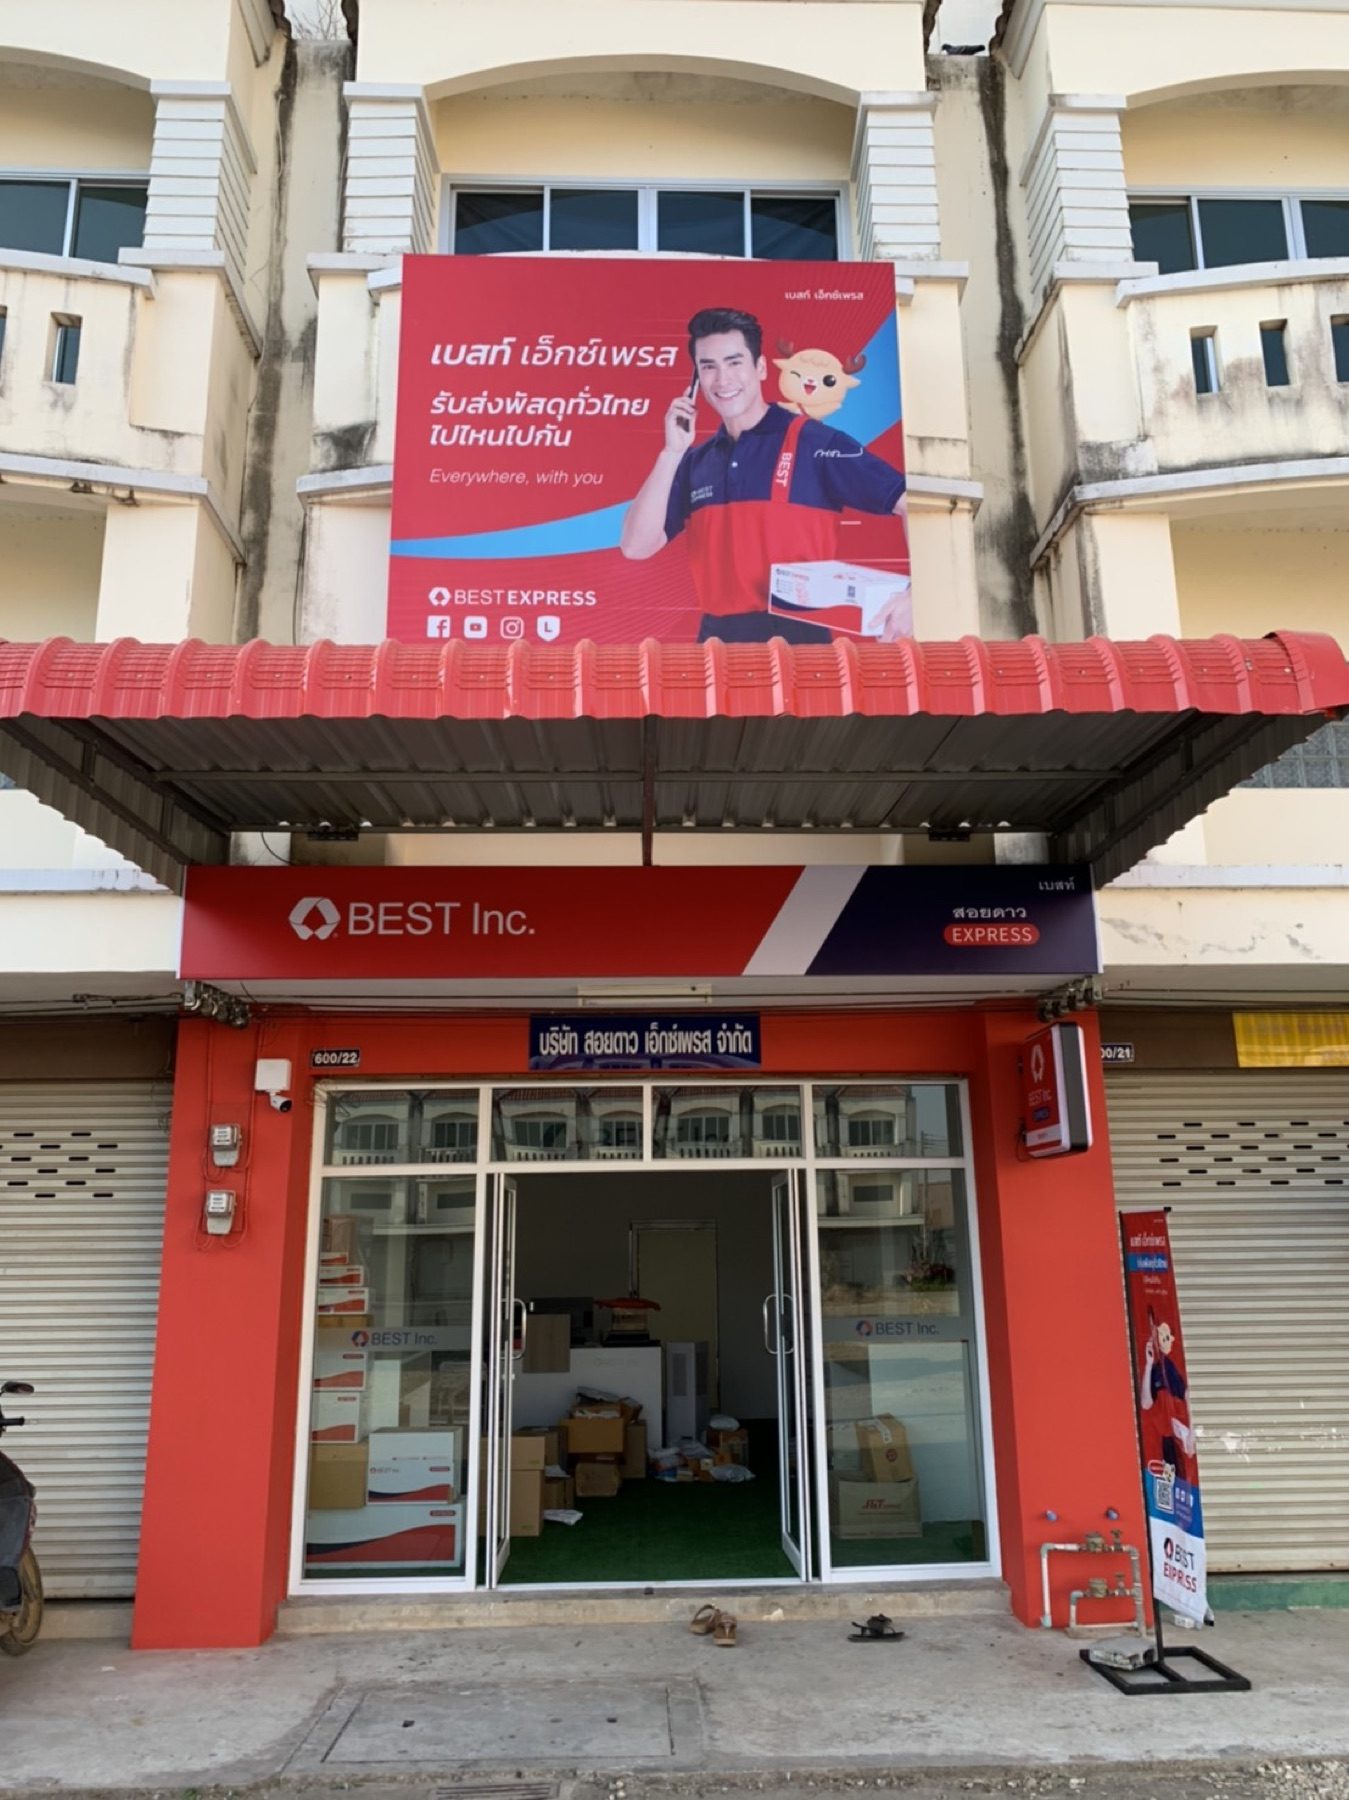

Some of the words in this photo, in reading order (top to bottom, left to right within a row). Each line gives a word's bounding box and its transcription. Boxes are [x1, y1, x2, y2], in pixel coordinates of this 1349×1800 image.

[430, 337, 517, 366] เบสท์
[520, 335, 679, 368] เอ็กซ์เพรส
[429, 386, 651, 422] รับส่งพัสดุทั่วไทย
[429, 424, 572, 447] ไปไหนไปกัน
[429, 468, 530, 487] Everywhere,
[536, 470, 569, 485] with
[572, 473, 604, 488] you
[775, 452, 793, 487] BEST
[1038, 876, 1076, 891] เบสท์
[347, 902, 460, 936] BEST
[471, 902, 536, 936] Inc.
[952, 906, 1027, 919] สอยดาว
[951, 927, 1033, 942] EXPRESS
[538, 1025, 579, 1056] บริษัท
[584, 1030, 639, 1055] สอยดาว
[644, 1022, 712, 1054] เอ็กซ์เพรส
[716, 1023, 752, 1054] จำกัด
[314, 1052, 358, 1064] 600/22
[875, 1321, 914, 1335] BEST
[917, 1322, 940, 1335] Inc.
[371, 1332, 411, 1346] BEST
[414, 1332, 438, 1345] Inc.
